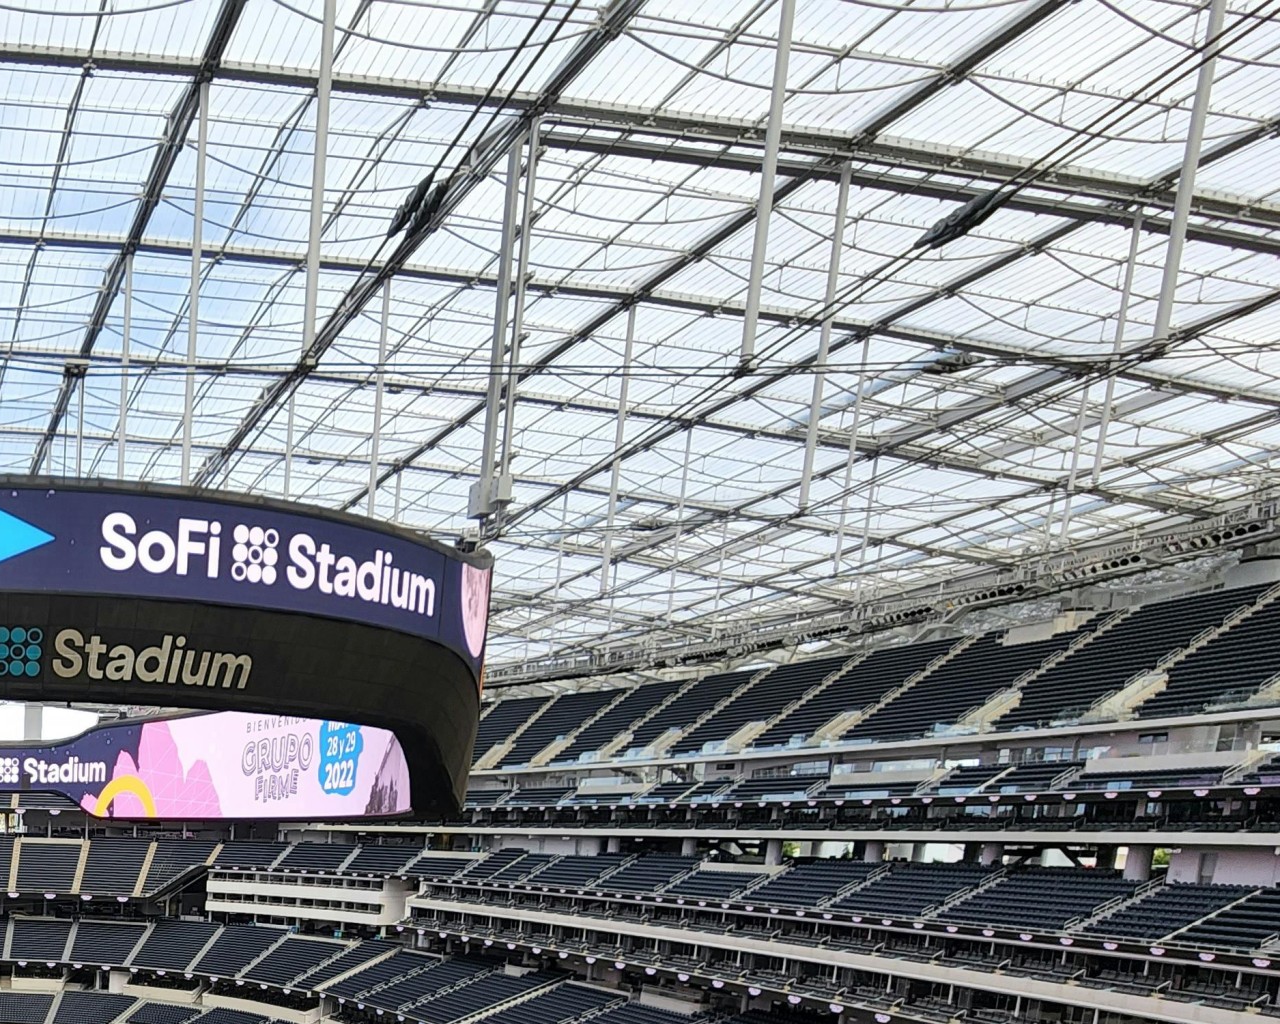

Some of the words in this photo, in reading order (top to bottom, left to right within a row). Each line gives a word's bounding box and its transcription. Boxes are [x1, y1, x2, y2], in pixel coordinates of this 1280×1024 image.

[100, 512, 223, 579] SoFi
[285, 533, 436, 617] Stadium
[52, 628, 254, 690] Stadium
[241, 732, 313, 777] GRUPO
[326, 736, 338, 757] 28
[345, 731, 356, 753] 29
[23, 756, 106, 784] Stadium
[254, 768, 299, 803] FIRME
[324, 759, 355, 791] 2022
